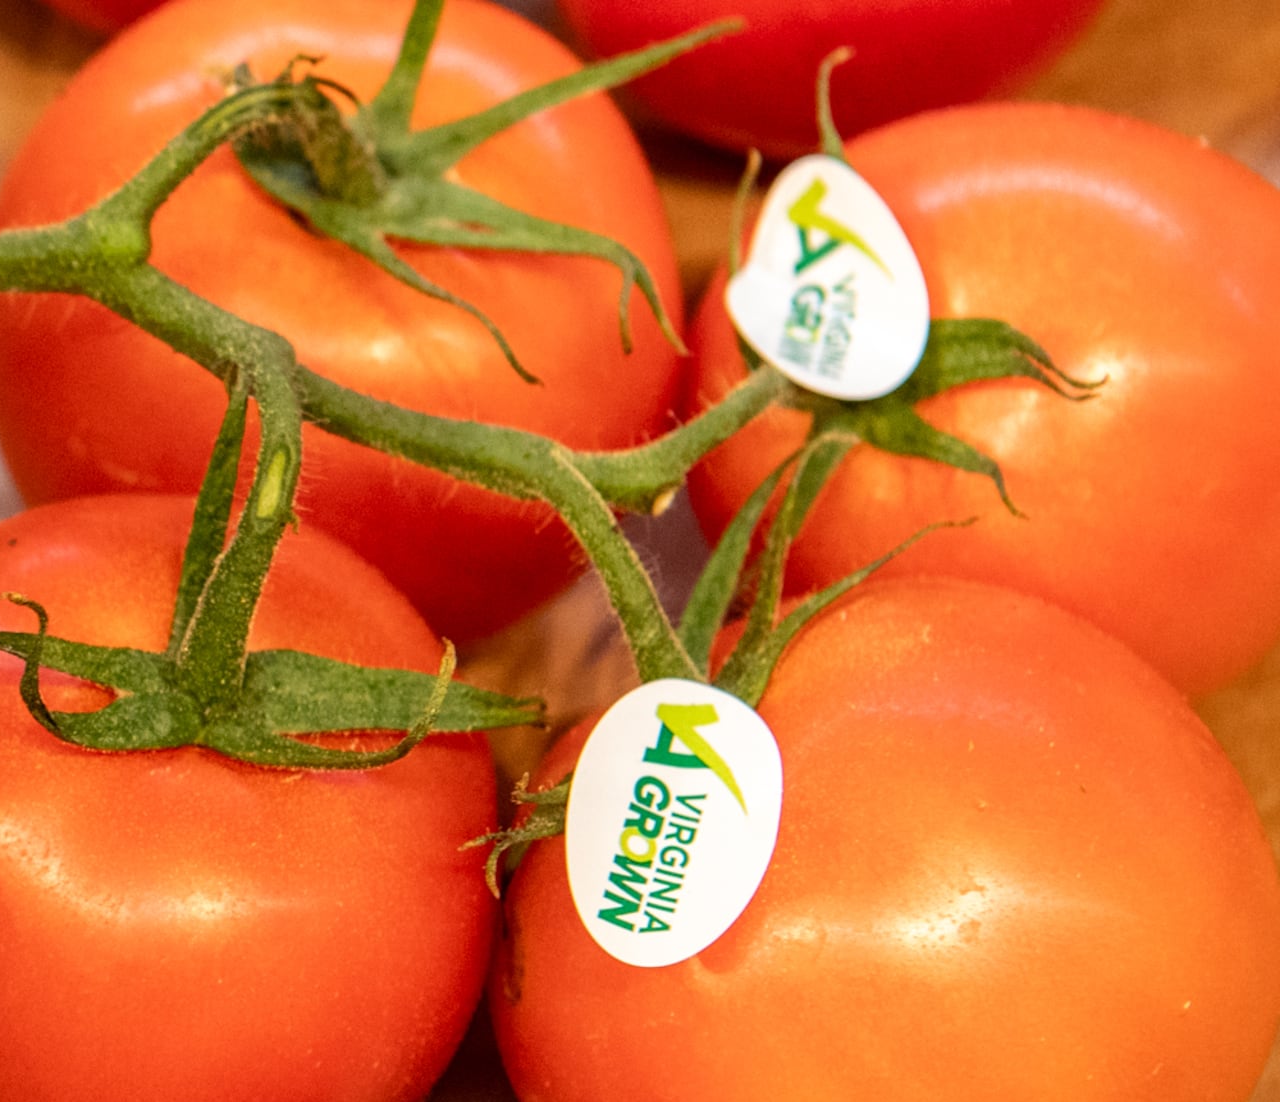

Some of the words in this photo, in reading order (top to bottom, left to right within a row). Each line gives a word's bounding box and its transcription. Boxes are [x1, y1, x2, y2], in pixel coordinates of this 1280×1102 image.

[778, 284, 827, 370] GRO
[597, 775, 670, 932] GROWN
[639, 793, 707, 934] VIRGINIA
